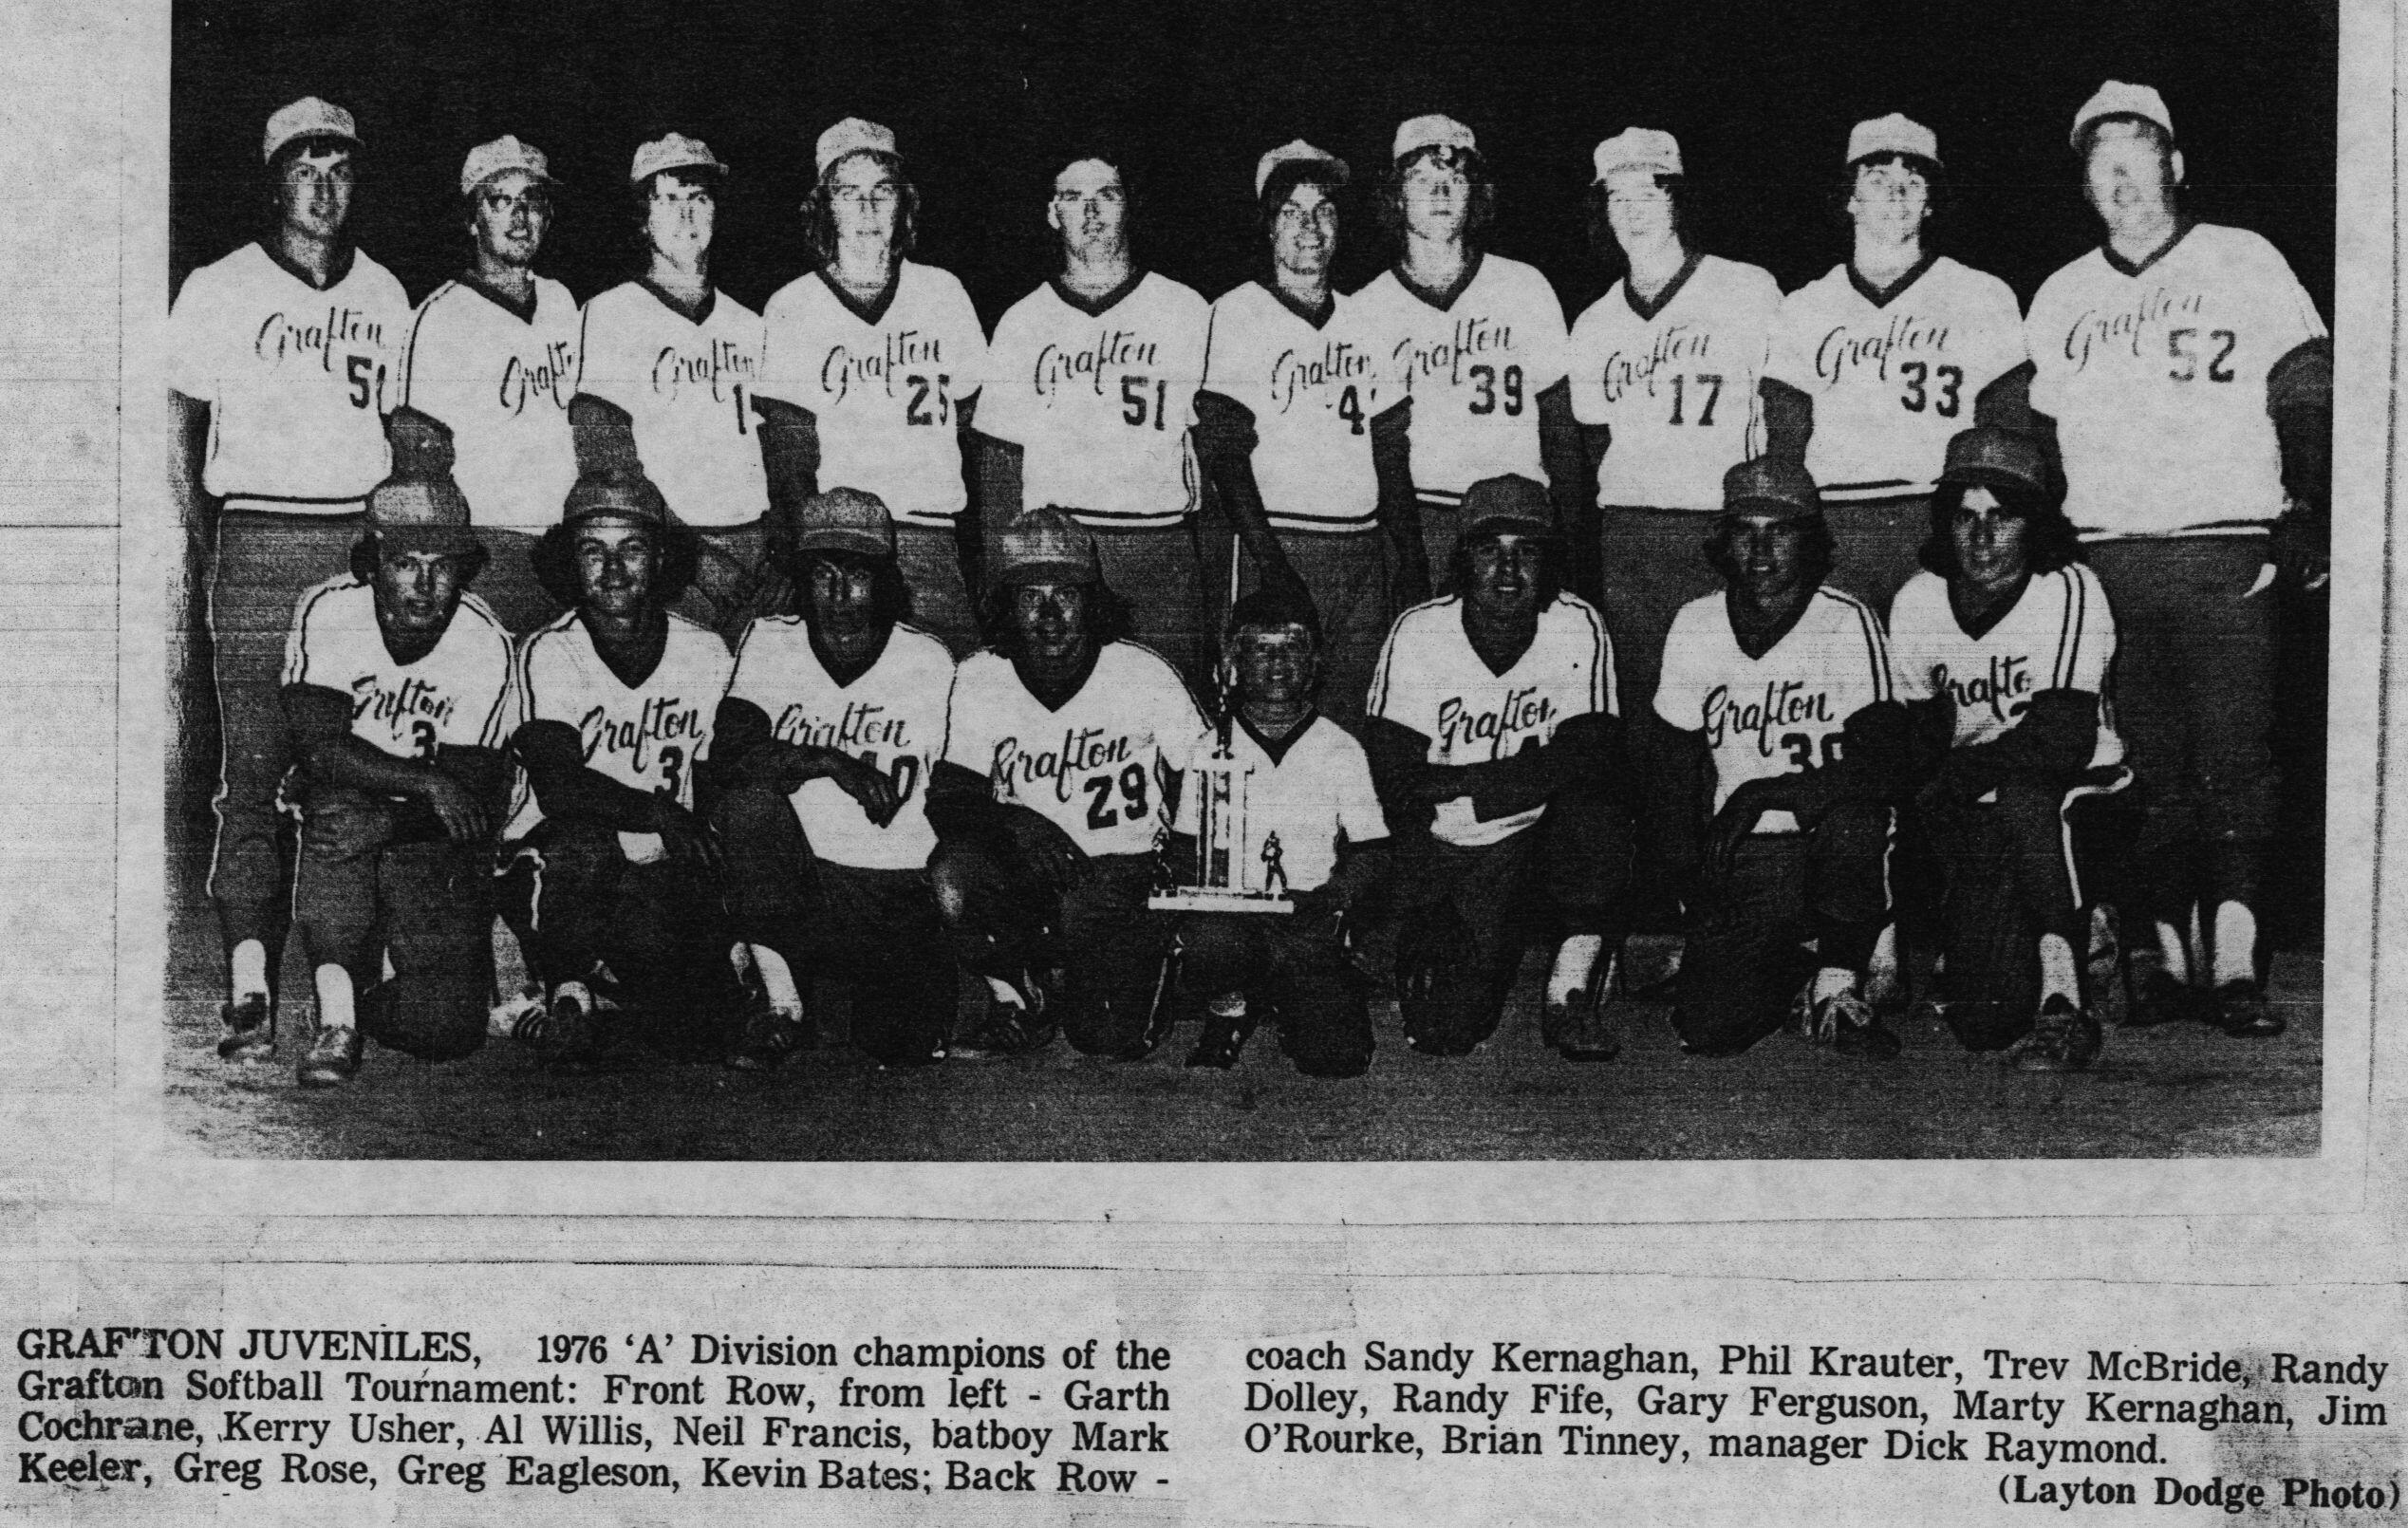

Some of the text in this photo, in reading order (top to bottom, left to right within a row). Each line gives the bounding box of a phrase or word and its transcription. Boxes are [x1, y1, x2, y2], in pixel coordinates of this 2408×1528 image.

[821, 330, 940, 405] Grafton
[1035, 330, 1158, 408] Grafton
[1815, 315, 1951, 392] Grafton
[2169, 328, 2236, 382] 52
[905, 374, 950, 426] 25
[1120, 376, 1167, 431] 51
[1467, 364, 1523, 416] 39
[1669, 374, 1724, 426] 17
[1900, 362, 1964, 418] 33
[579, 697, 707, 774] Grafton
[1702, 680, 1834, 758] Grafton
[995, 727, 1131, 804] Grafton
[1083, 762, 1149, 830] 29
[17, 1327, 223, 1360] GRAFTON
[239, 1330, 482, 1369] JUVENILES,
[537, 1334, 608, 1365] 1976
[691, 1333, 838, 1367] Division
[853, 1336, 1045, 1375] champions
[1062, 1338, 1098, 1370] of
[1115, 1339, 1171, 1371] the
[1245, 1340, 2389, 1392] coach Sandy Kernaghan, Phil Krauter, Trev McBride, Randy
[17, 1368, 165, 1402] Grafton
[186, 1369, 324, 1402] Softball
[345, 1371, 577, 1405] Tournament:
[603, 1373, 705, 1406] Front
[725, 1374, 815, 1413] Row,
[839, 1376, 925, 1408] from
[947, 1377, 1008, 1409] left
[1064, 1379, 1170, 1411] Garth
[1243, 1381, 2388, 1431] Dolley, Randy Fife, Gary Ferguson, Marty Kernaghan, Jim
[18, 1408, 1169, 1458] Cochrane, Kerry Usher, Al Willis, Neil Francis, batboy Mark
[1244, 1422, 2168, 1469] O’Rourke, Brian Tinney, manager Dick Raymond.
[18, 1449, 153, 1488] Keeler,
[174, 1451, 263, 1490] Greg
[280, 1452, 378, 1490] Rose,
[398, 1454, 487, 1493] Greg
[505, 1455, 680, 1494] Eagleson,
[701, 1457, 807, 1489] Kevin
[818, 1459, 931, 1495] Bates;
[944, 1460, 1036, 1492] Back
[1055, 1460, 1138, 1493] Row
[1999, 1474, 2401, 1515] (Layton Dodge Photo)
